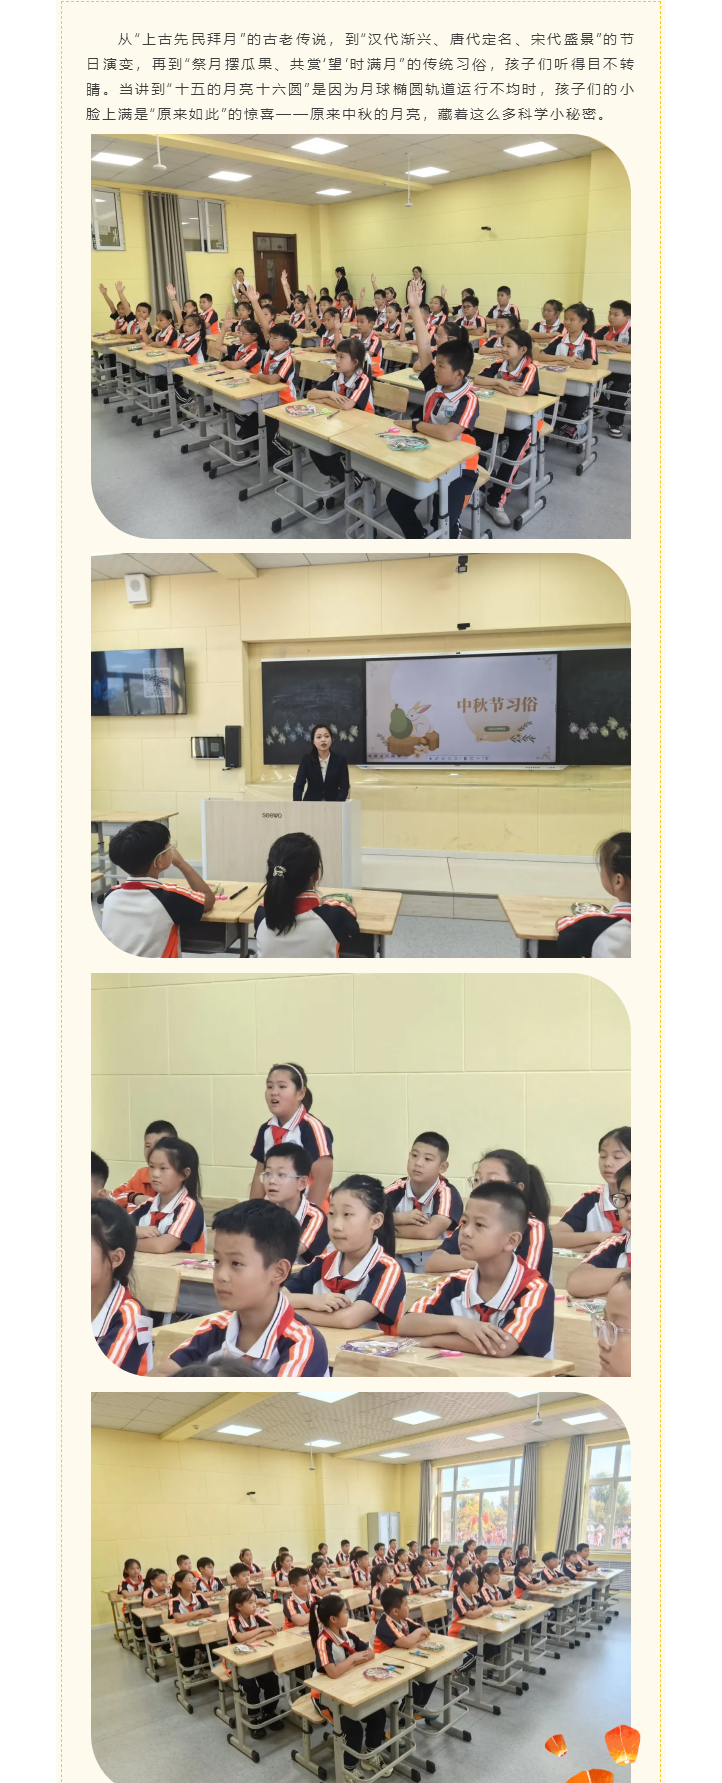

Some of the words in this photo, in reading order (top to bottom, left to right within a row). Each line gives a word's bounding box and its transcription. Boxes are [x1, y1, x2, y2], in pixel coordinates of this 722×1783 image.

[456, 696, 539, 715] 中秋节习俗
